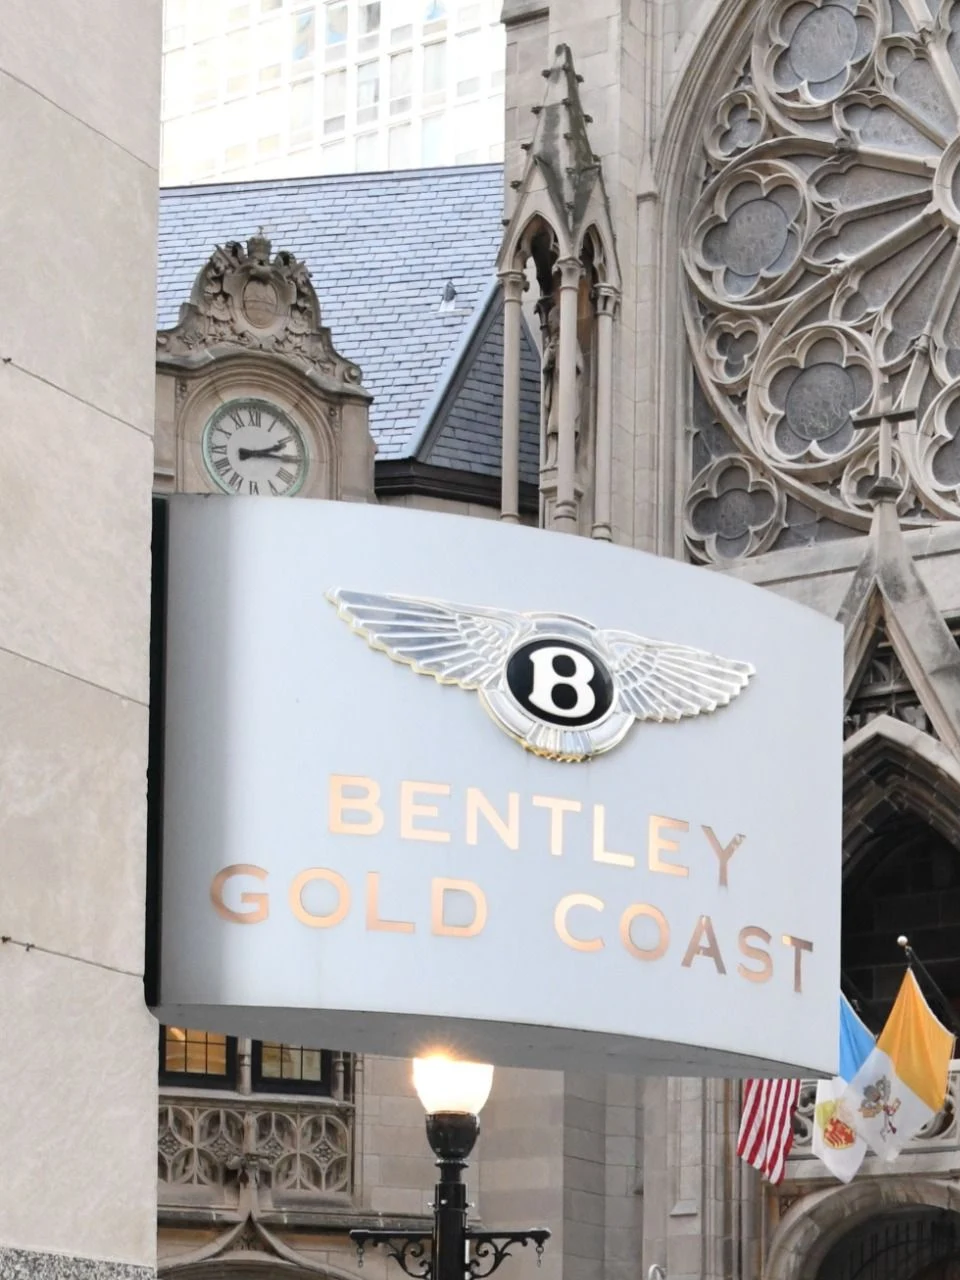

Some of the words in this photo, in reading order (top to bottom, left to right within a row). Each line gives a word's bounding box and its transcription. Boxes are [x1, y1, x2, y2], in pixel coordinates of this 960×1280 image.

[528, 646, 596, 719] B
[327, 772, 747, 888] BENTLEY
[208, 863, 489, 940] GOLD
[553, 891, 815, 994] COAST
